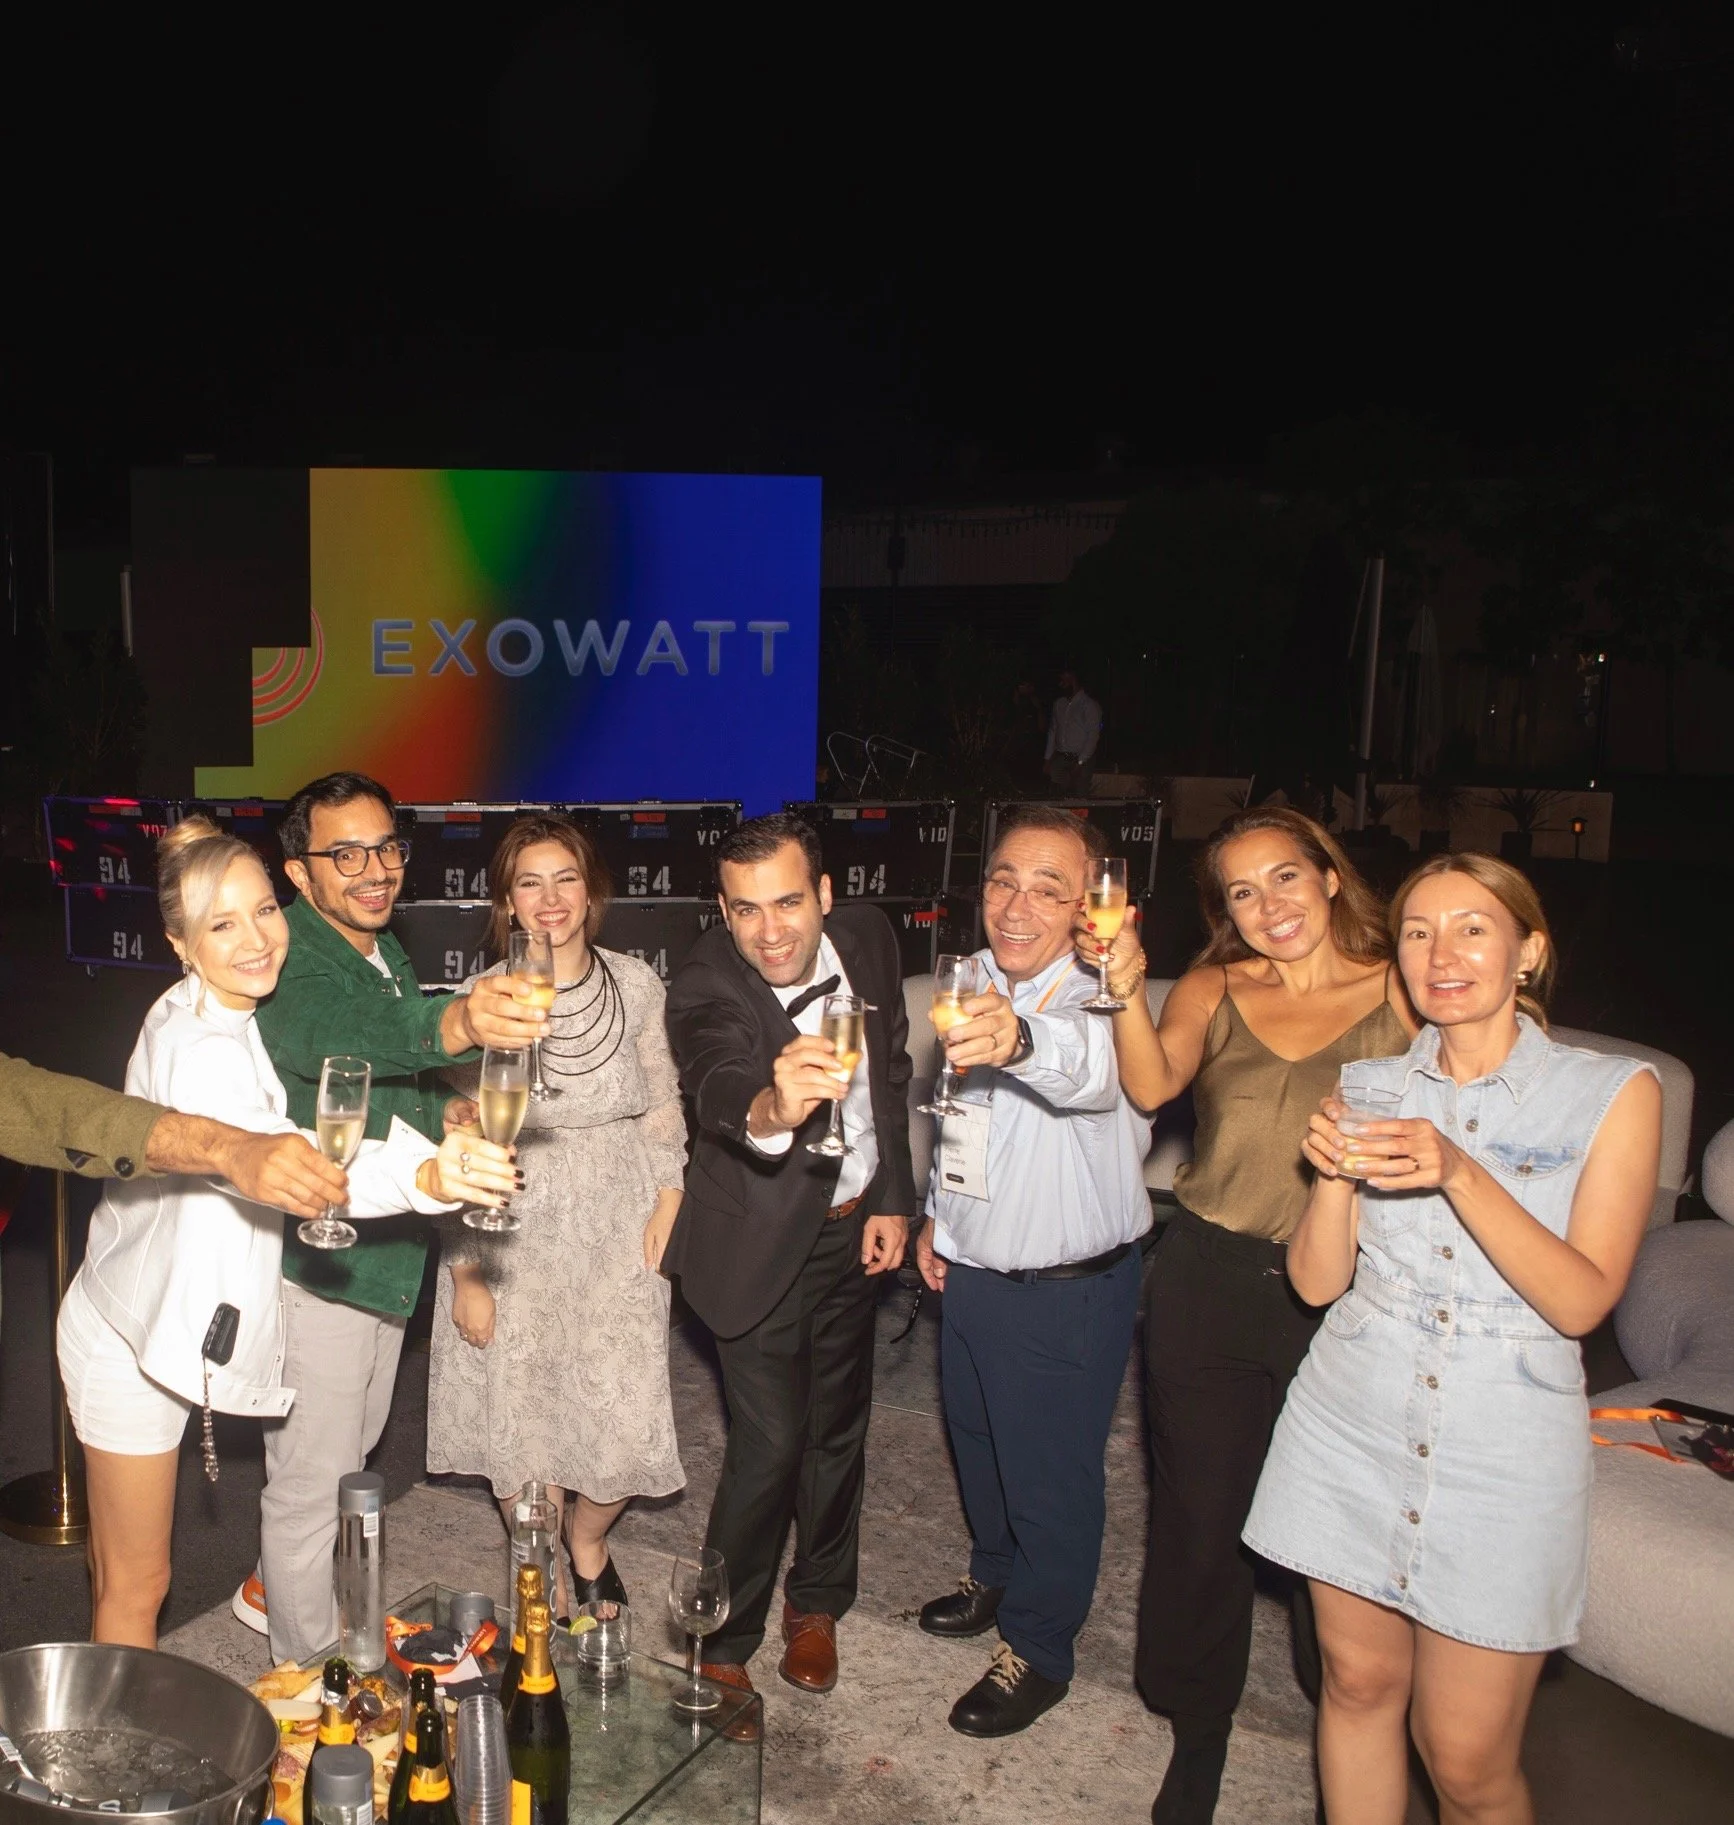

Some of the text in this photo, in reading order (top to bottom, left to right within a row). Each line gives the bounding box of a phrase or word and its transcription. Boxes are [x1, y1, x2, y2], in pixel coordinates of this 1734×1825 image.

[371, 618, 790, 677] EXOWATT
[99, 856, 131, 885] 94
[444, 867, 489, 898] 94
[628, 865, 672, 896] 94
[847, 864, 887, 896] 94
[113, 931, 143, 961] 94
[444, 950, 486, 979] 94
